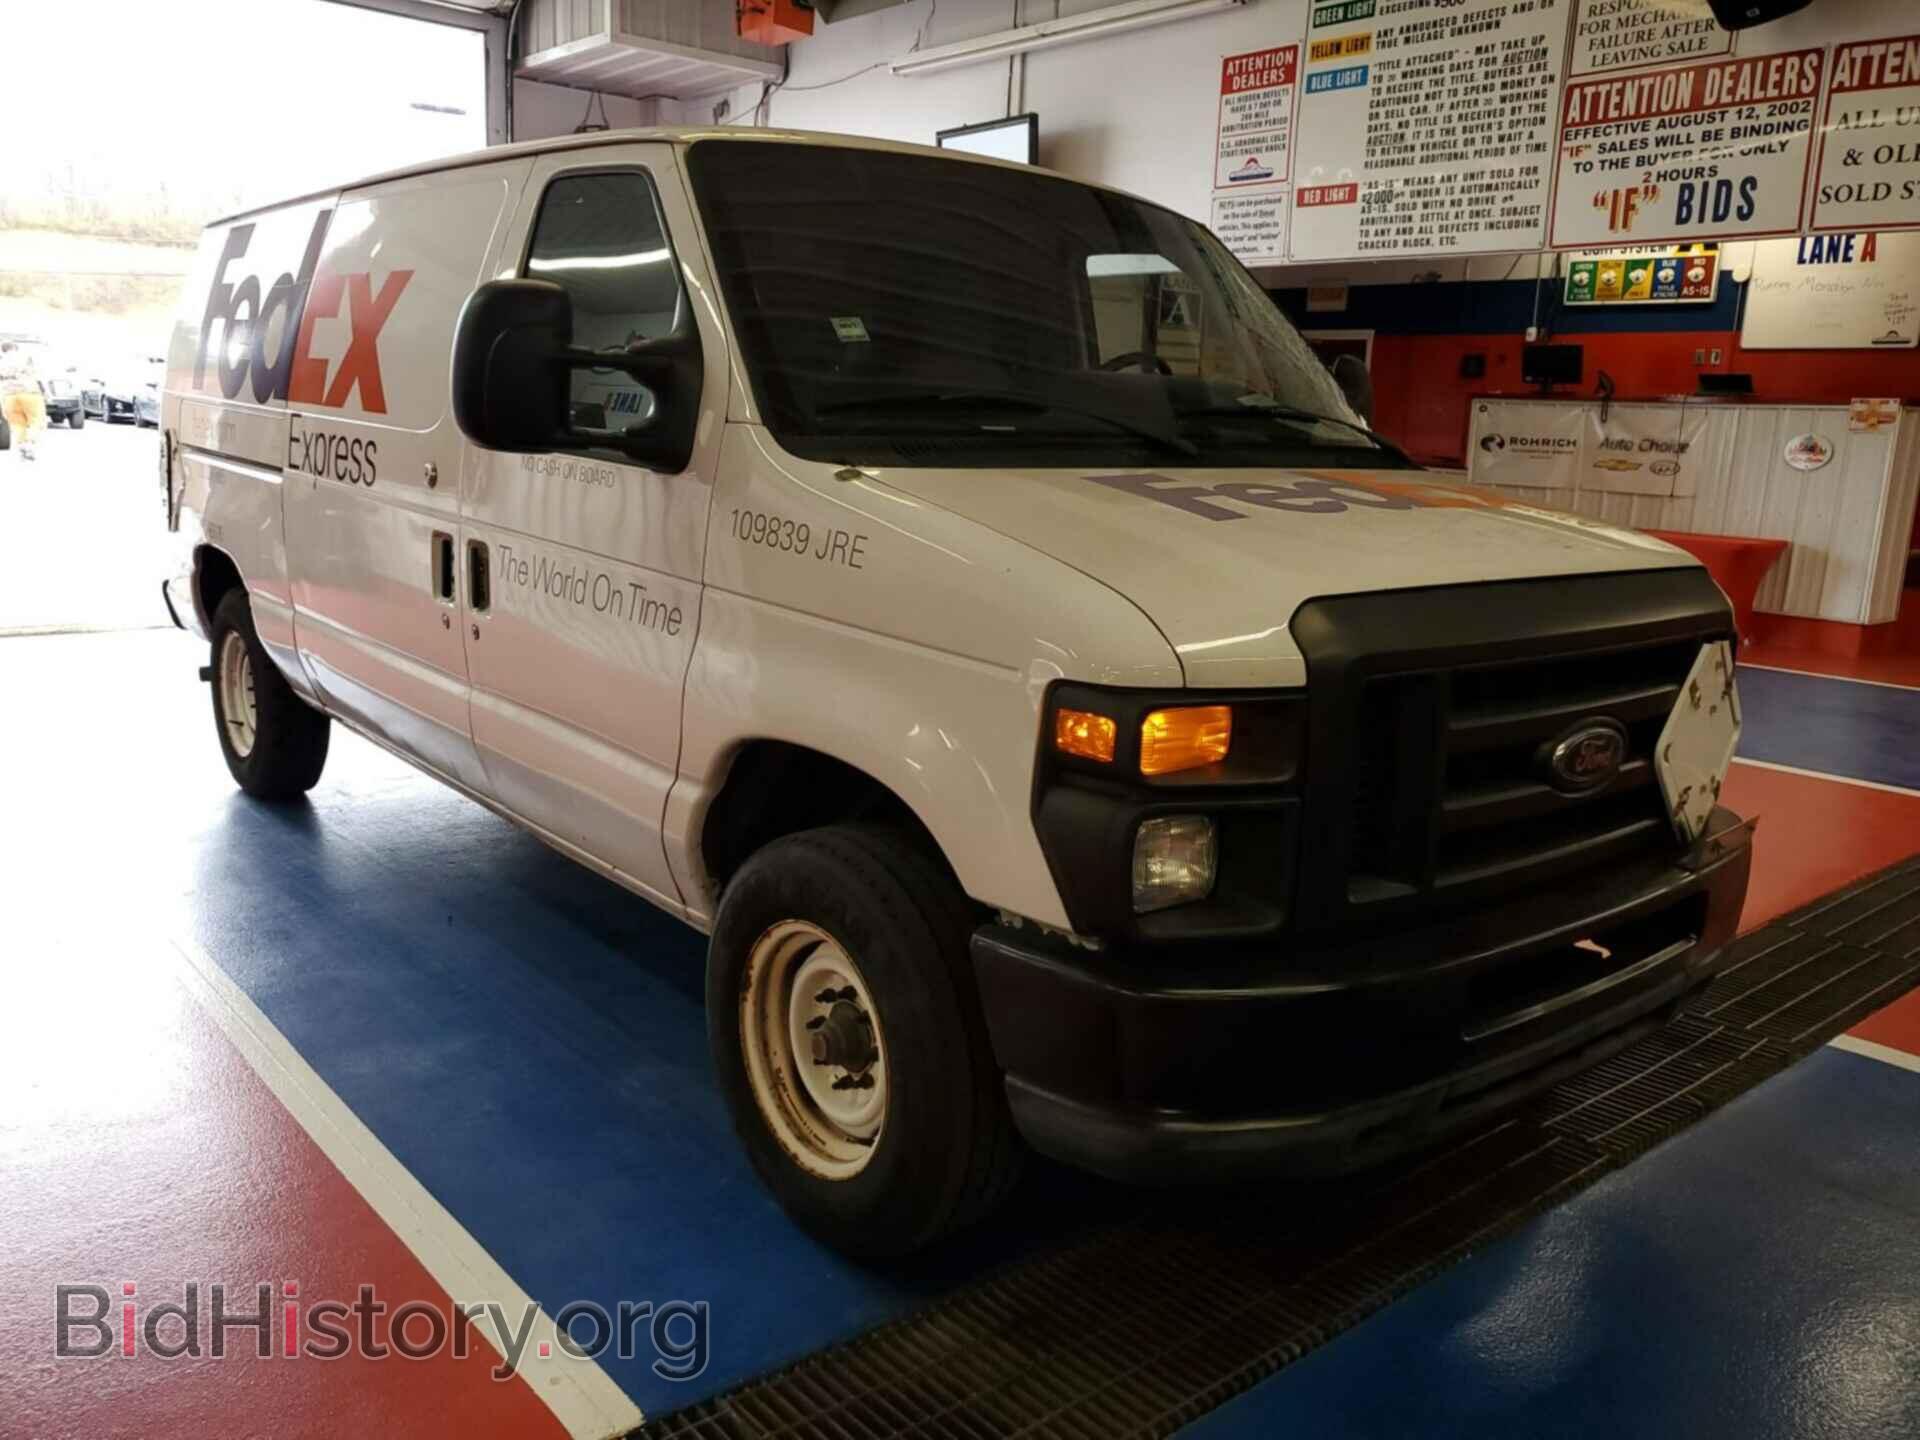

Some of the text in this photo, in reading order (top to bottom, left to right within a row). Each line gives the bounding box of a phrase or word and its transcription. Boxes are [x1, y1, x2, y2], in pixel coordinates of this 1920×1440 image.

[1315, 1, 1374, 25] GREEN LIGHT
[1376, 1, 1534, 39] ANY ANNOUNCED DEFECTS AND
[1376, 19, 1501, 50] TRUE MILEAGE UNKNOWN
[1579, 18, 1611, 36] FOR
[1588, 17, 1715, 51] FAILURE AFTER
[1311, 35, 1371, 59] YELLOW LIGHT
[1475, 43, 1496, 55] MAY
[1501, 37, 1526, 50] TAKE
[1531, 34, 1546, 46] UP
[1591, 36, 1708, 68] LEAVING SALE
[1226, 49, 1294, 76] ATTENTION
[1373, 47, 1549, 85] TO WORKING DAYS FOR AUCTION
[1232, 67, 1286, 90] DEALERS
[1311, 69, 1363, 91] BLUE LIGHT
[1369, 74, 1555, 109] CAUTIONED NOT TO SPEND MONEY ON
[1372, 61, 1548, 97] TO RECEIVE THE BUYERS ARE
[1565, 53, 1819, 124] ATTENTION DEALERS
[1368, 88, 1548, 121] OR SELL IF AFTER WORKING
[1397, 102, 1547, 130] NO TITLE IS RECEIVED BY THE
[1412, 116, 1546, 140] IT IS THE BUYER'S OPTION
[1564, 100, 1812, 142] EFFECTIVE AUGUST 12, 2002
[1836, 108, 1885, 130] ALL
[1366, 130, 1534, 158] TO RETURN VEHICLE OR TO WAIT A
[1563, 119, 1810, 158] "IF" SALES WILL BE BINDING
[1364, 142, 1547, 168] REASONABLE ADDITIONAL PERIOD OF TIME
[1573, 161, 1594, 174] TO
[1598, 157, 1630, 171] THE
[1740, 139, 1790, 157] ONLY
[1843, 147, 1864, 166] &
[1403, 166, 1539, 187] MEANS ANY UNIT SOLD FOR
[1642, 165, 1719, 184] 2 HOURS
[1304, 187, 1351, 204] RED LIGHT
[1410, 187, 1440, 199] UNDER
[1445, 186, 1455, 195] IS
[1460, 179, 1540, 194] AUTOMATICALLY
[1819, 179, 1920, 204] SOLD S
[1394, 195, 1496, 212] SOLD WITH NO DRIVE
[1420, 205, 1541, 222] SETTLE AT SUBJECT
[1593, 176, 1758, 231] "IF" BIDS
[1359, 218, 1539, 238] TO ANY AND ALL DEFECTS INCLUDING
[1358, 239, 1398, 250] CRACKED
[1797, 232, 1877, 265] LANE A
[1682, 286, 1710, 297] AS-IS
[192, 208, 416, 415] FedEx
[288, 413, 378, 490] Express
[1509, 436, 1578, 447] ROHRICH
[1599, 437, 1691, 454] Auto Choice
[536, 457, 560, 477] CASH
[563, 462, 578, 480] ON
[579, 466, 616, 488] BOARD
[732, 508, 869, 569] 109839 JRE
[498, 545, 684, 637] The World On Time
